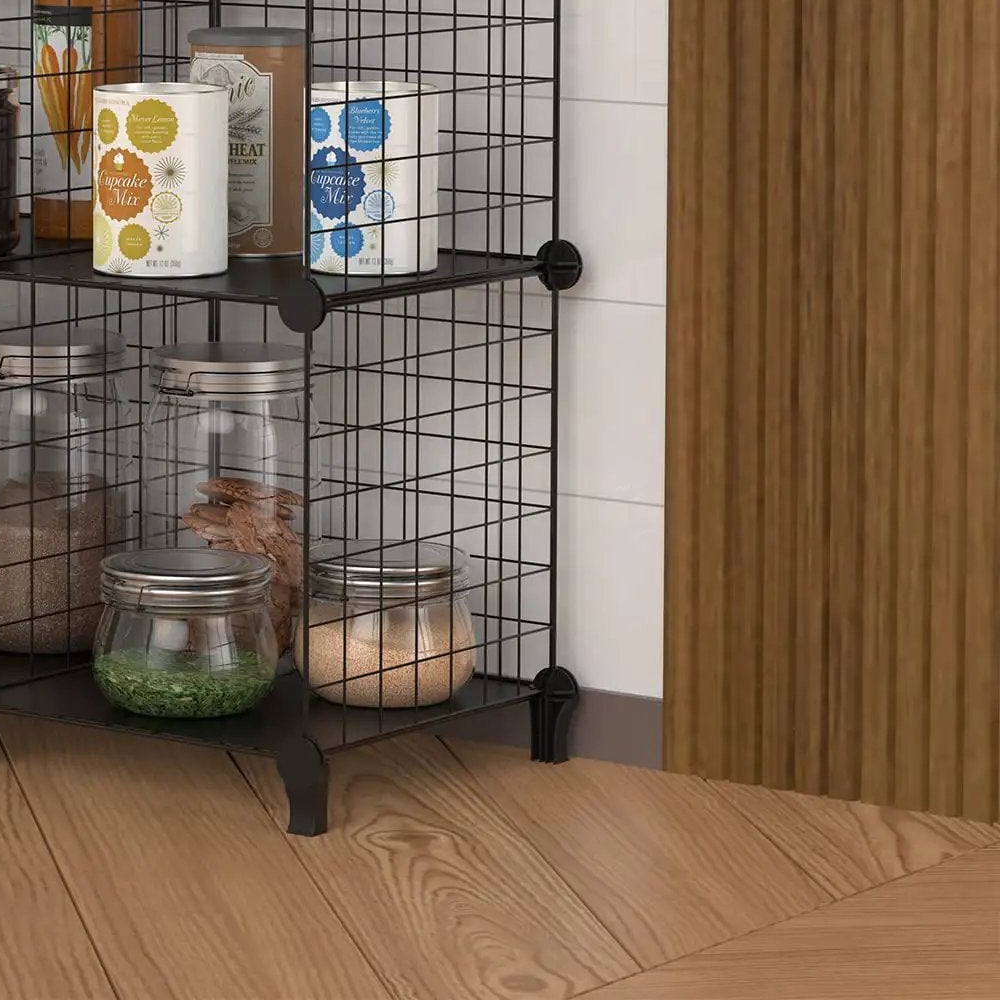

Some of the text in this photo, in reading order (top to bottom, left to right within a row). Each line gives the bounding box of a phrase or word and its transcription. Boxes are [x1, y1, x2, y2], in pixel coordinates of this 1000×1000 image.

[228, 143, 266, 157] HEAT
[99, 169, 148, 190] Cupcake
[109, 188, 141, 206] Mix
